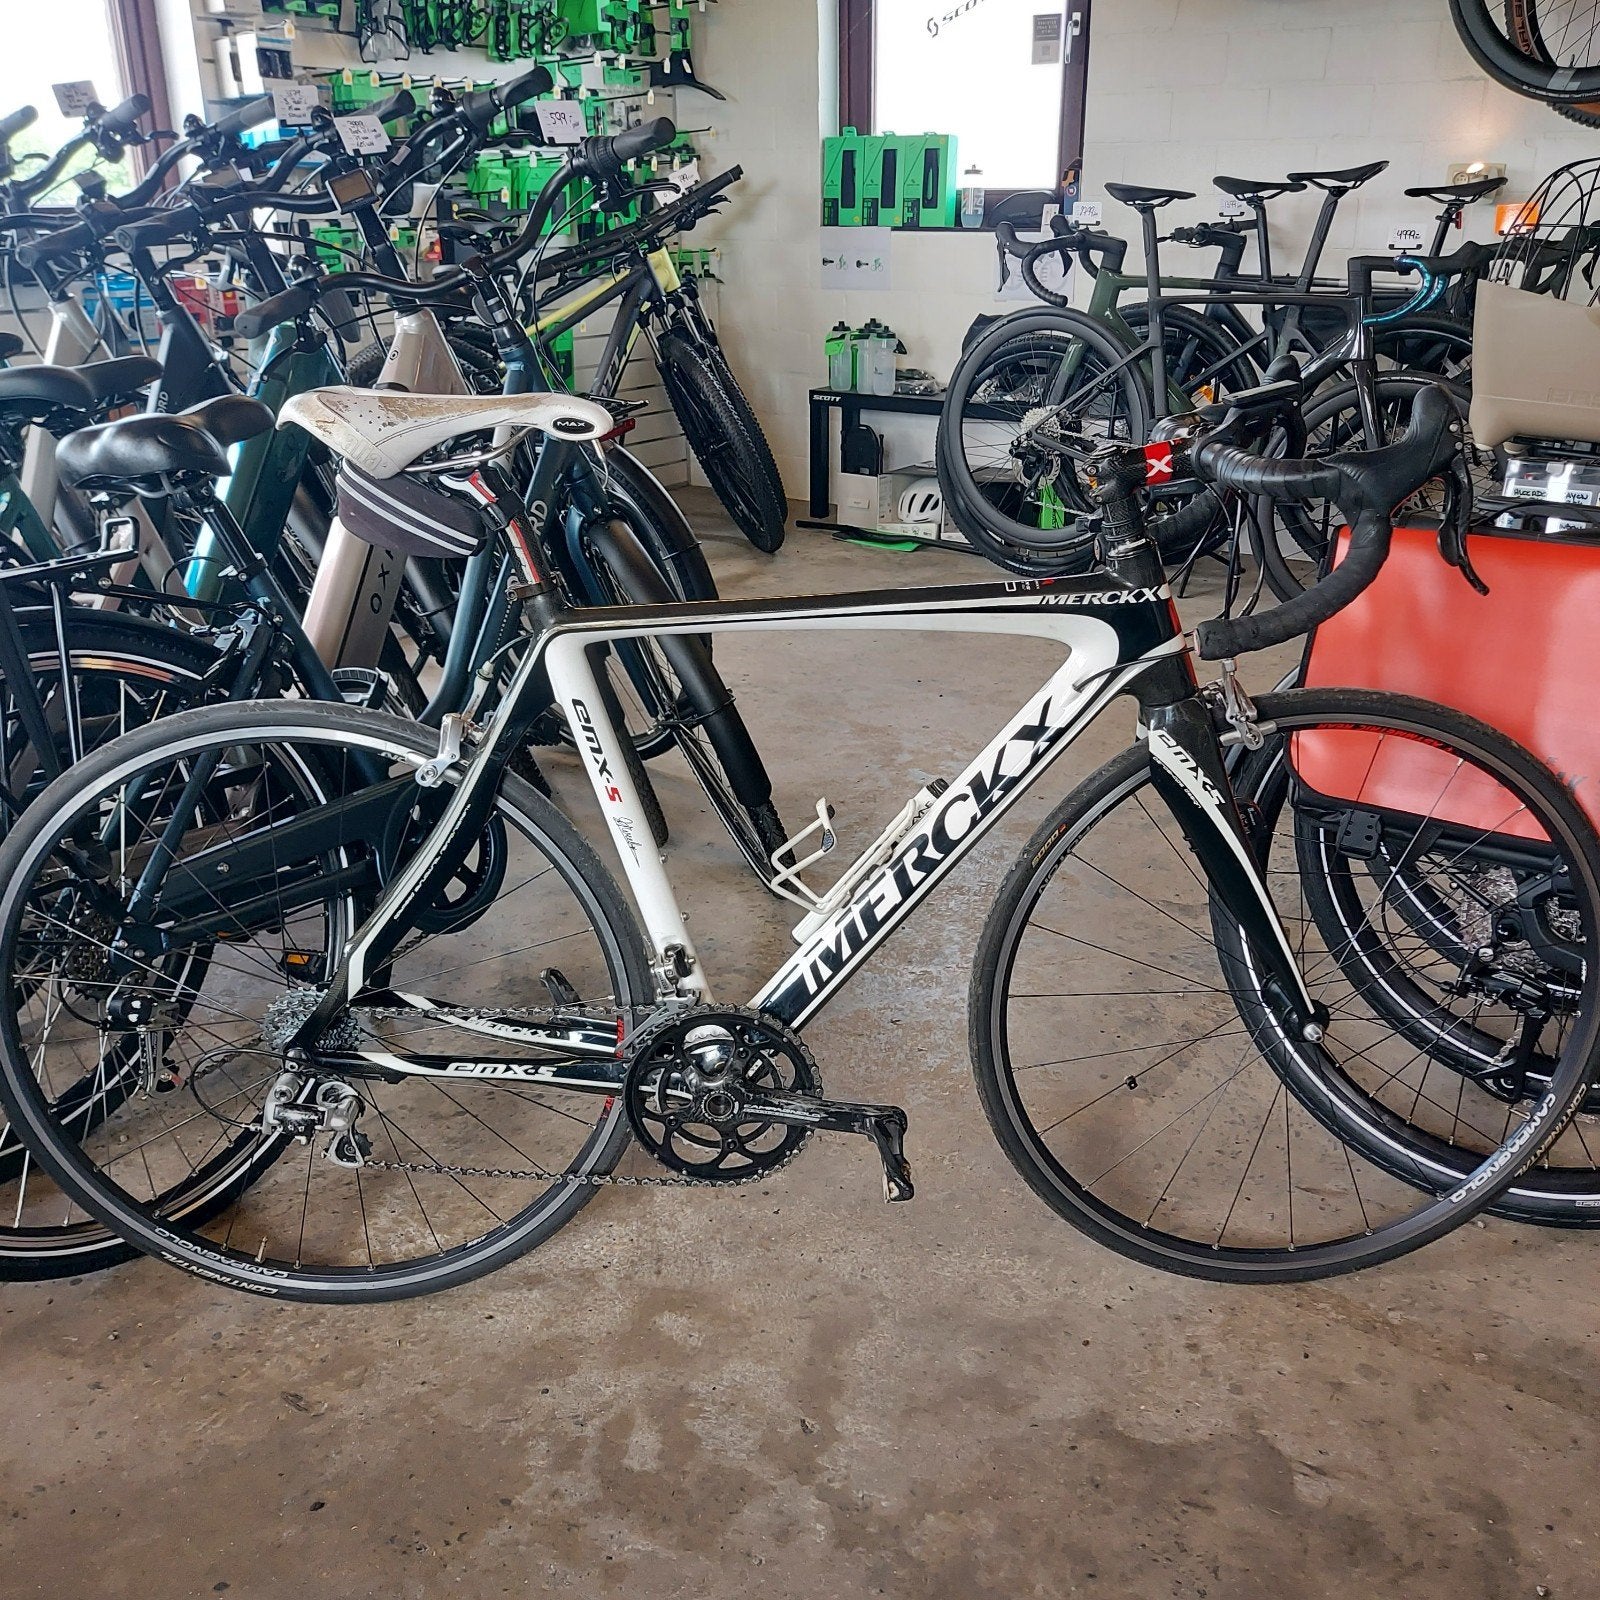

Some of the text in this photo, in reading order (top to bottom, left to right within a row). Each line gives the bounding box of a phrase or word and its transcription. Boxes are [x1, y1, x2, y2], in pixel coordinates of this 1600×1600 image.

[812, 394, 842, 402] SCOTT
[1039, 586, 1161, 606] MERCKX
[801, 697, 1068, 998] MERCKX
[467, 1014, 551, 1039] MERCKX
[1448, 1092, 1558, 1205] CAMPAGNOLO
[1514, 1084, 1588, 1179] CONTINENTAL
[154, 1225, 290, 1280] CAMPAGNOLO
[160, 1250, 280, 1297] CONTINENTAL
